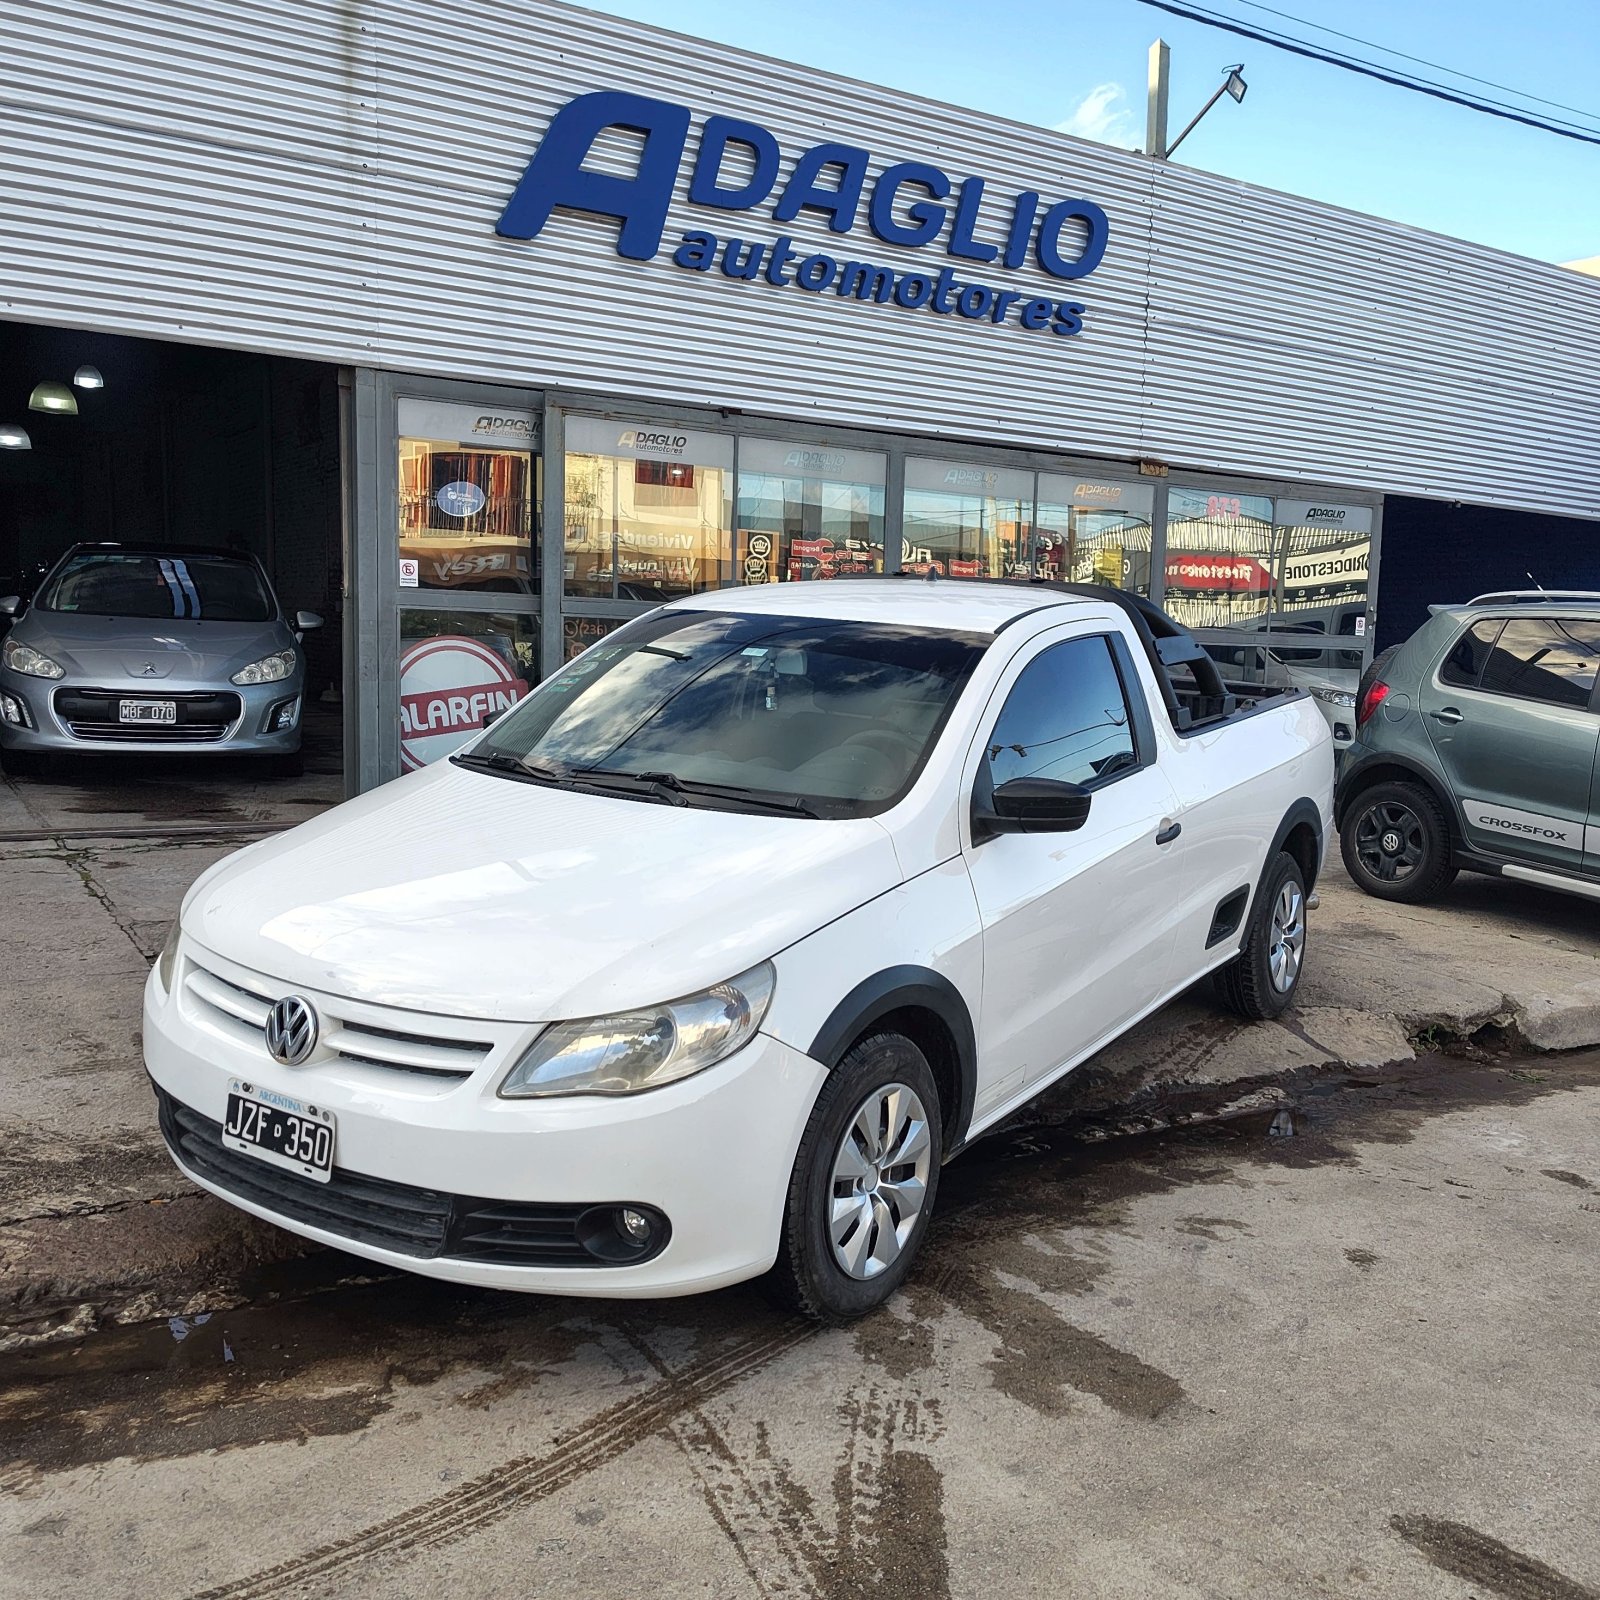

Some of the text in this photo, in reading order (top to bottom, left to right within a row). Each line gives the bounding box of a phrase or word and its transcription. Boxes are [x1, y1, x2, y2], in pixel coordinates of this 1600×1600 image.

[495, 91, 1109, 280] ADAGLIO
[674, 229, 1086, 336] automotores
[617, 430, 687, 448] ADAGLIO
[1305, 508, 1346, 519] ADAGLIO
[121, 706, 174, 719] MBF 070
[1478, 816, 1568, 841] CROSSFOX
[258, 1089, 303, 1113] ARGENTINA
[227, 1098, 272, 1143] JZF
[284, 1116, 330, 1167] 350
